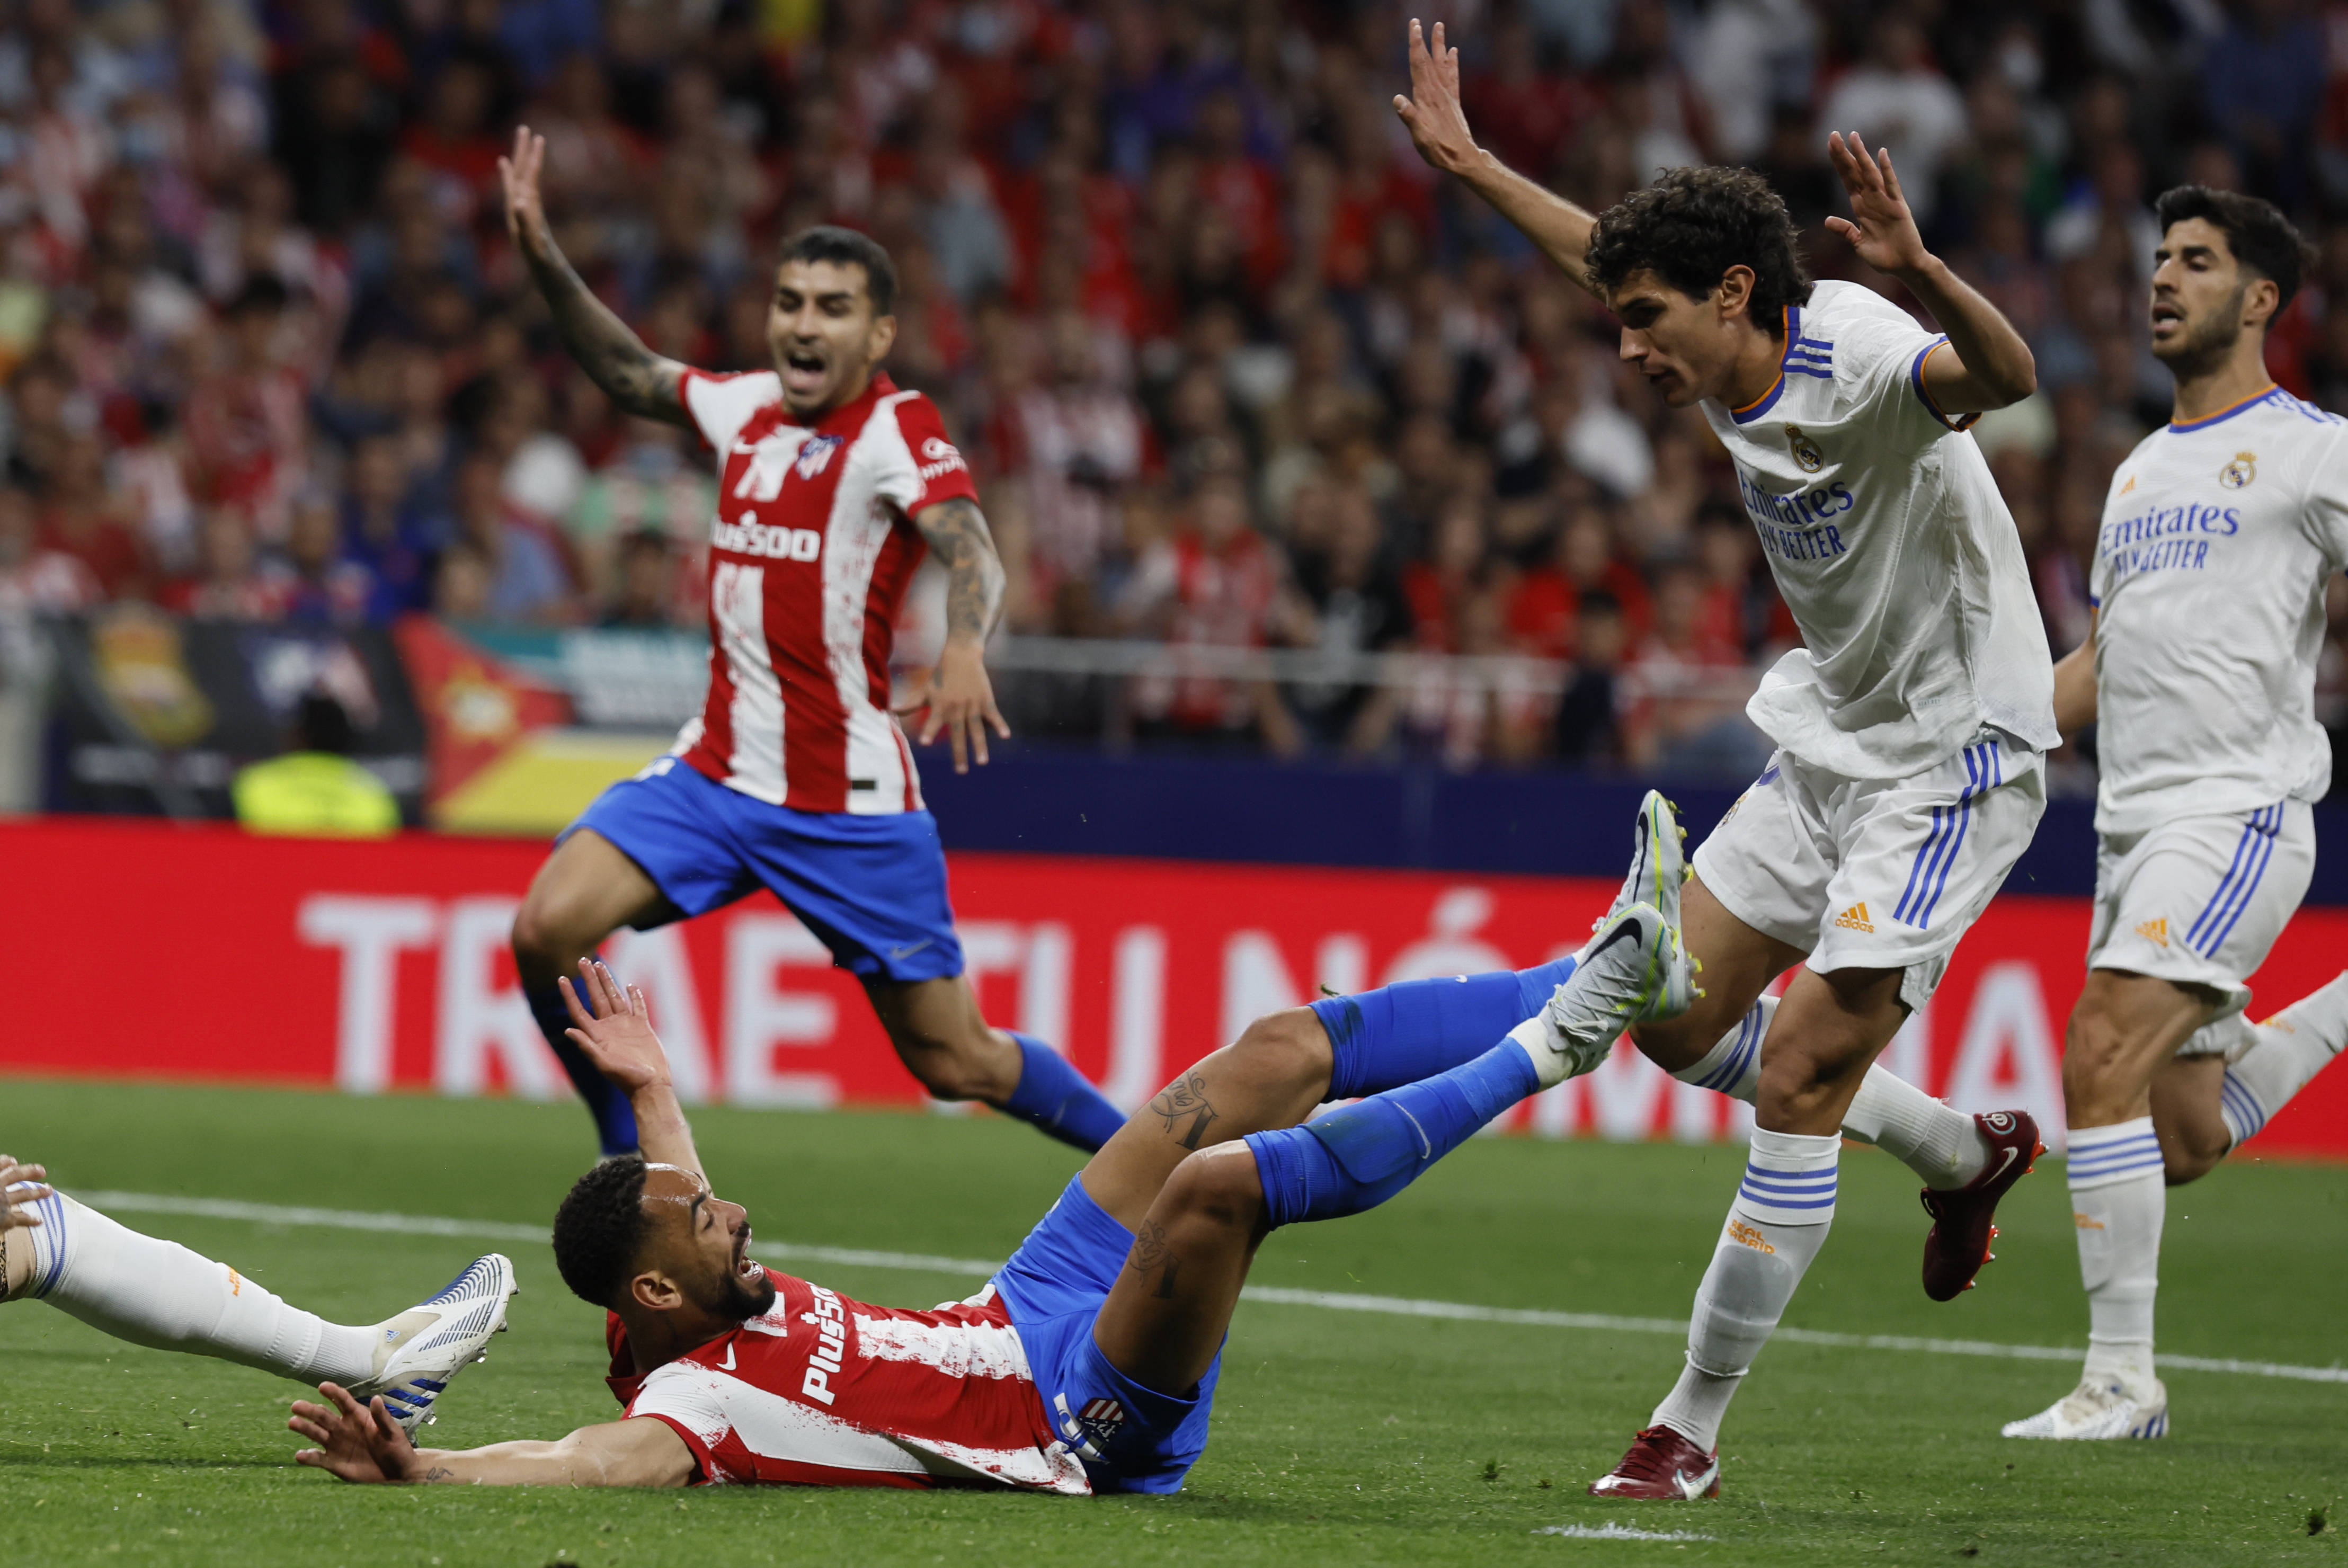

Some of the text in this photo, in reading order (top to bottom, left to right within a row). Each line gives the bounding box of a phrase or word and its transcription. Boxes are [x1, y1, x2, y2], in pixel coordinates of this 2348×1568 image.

[1740, 469, 1854, 525] Emirates
[709, 513, 821, 563] lus500
[1779, 525, 1847, 560] BETTER
[2102, 501, 2241, 558] Emirates
[1835, 918, 1875, 933] adidas
[298, 892, 844, 1112] TRAE
[922, 919, 1171, 1124] U
[1732, 1219, 1765, 1243] REAL
[801, 1280, 846, 1406] Plus50
